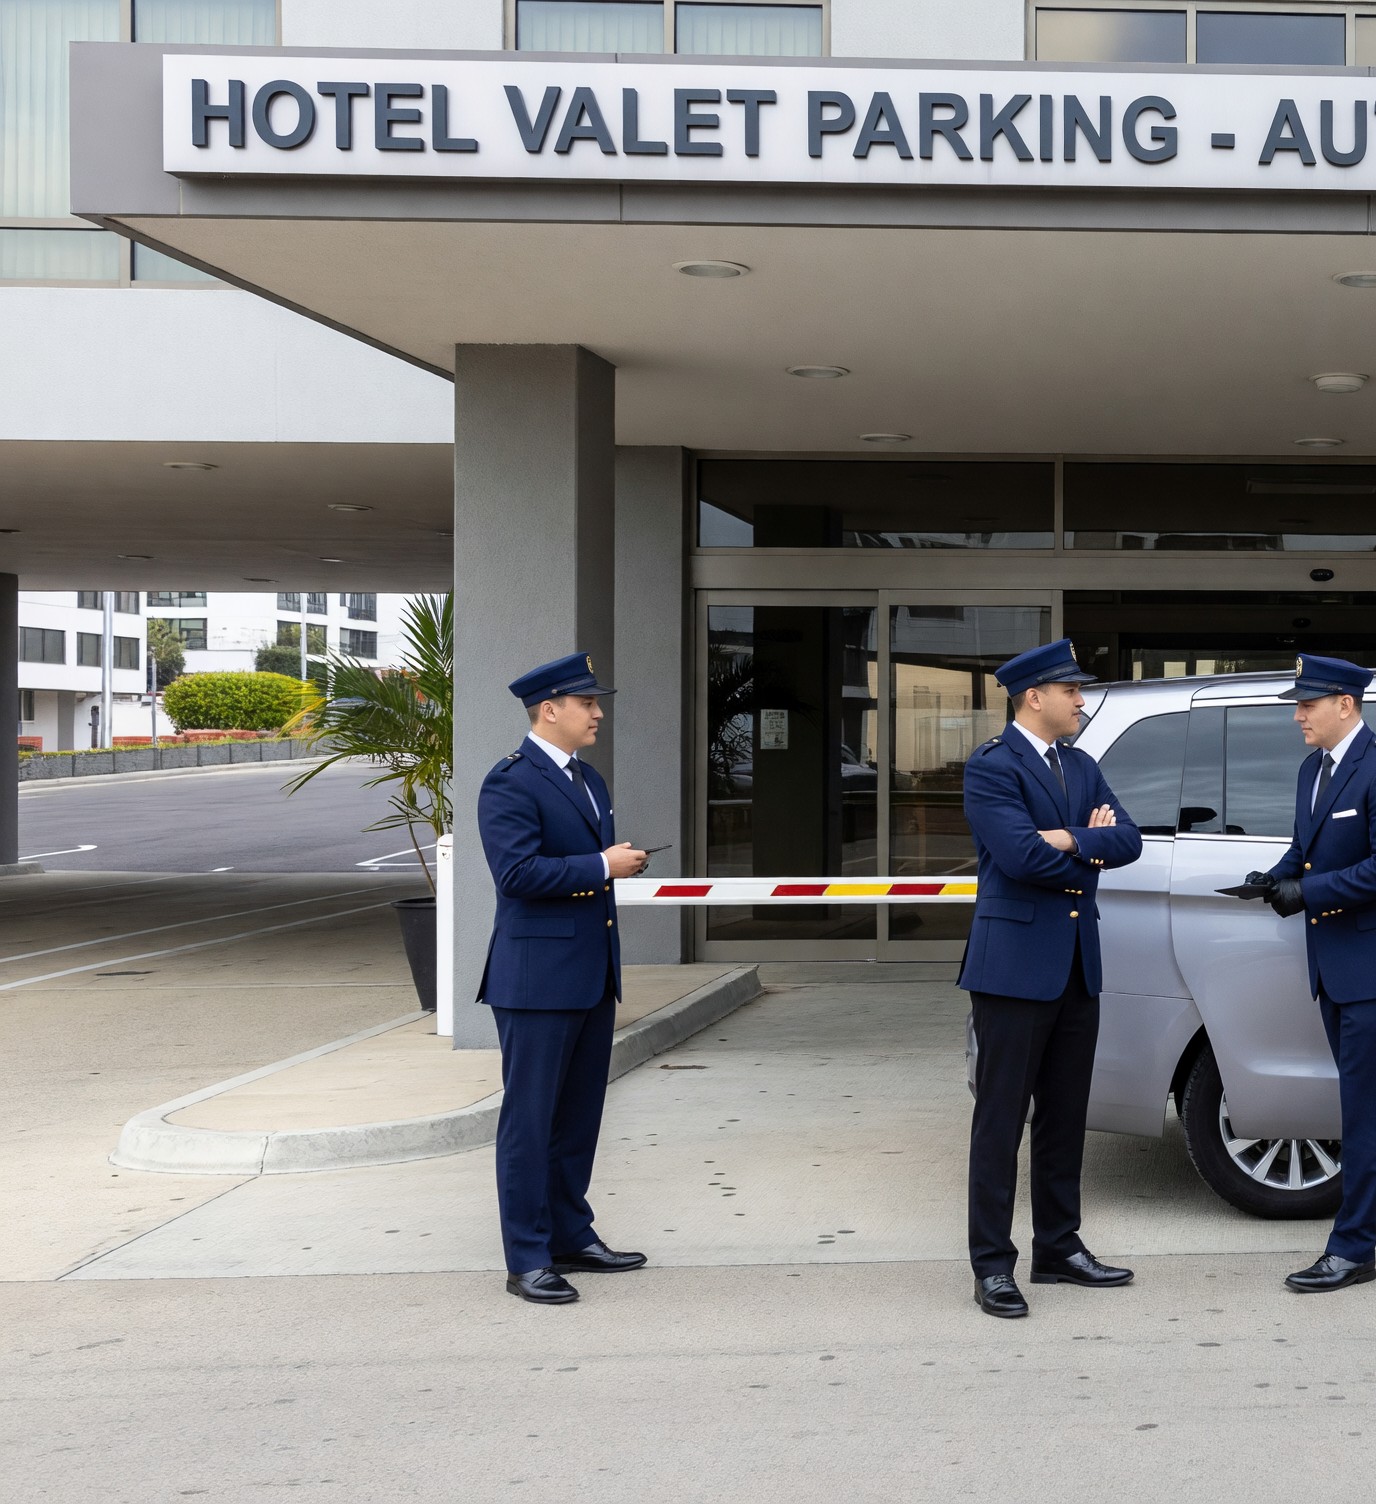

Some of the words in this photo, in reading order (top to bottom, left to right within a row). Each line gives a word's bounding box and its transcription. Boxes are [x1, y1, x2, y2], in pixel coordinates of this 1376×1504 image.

[191, 78, 478, 153] HOTEL
[503, 85, 777, 158] VALET
[807, 91, 1177, 165] PARKING
[1211, 133, 1235, 149] -
